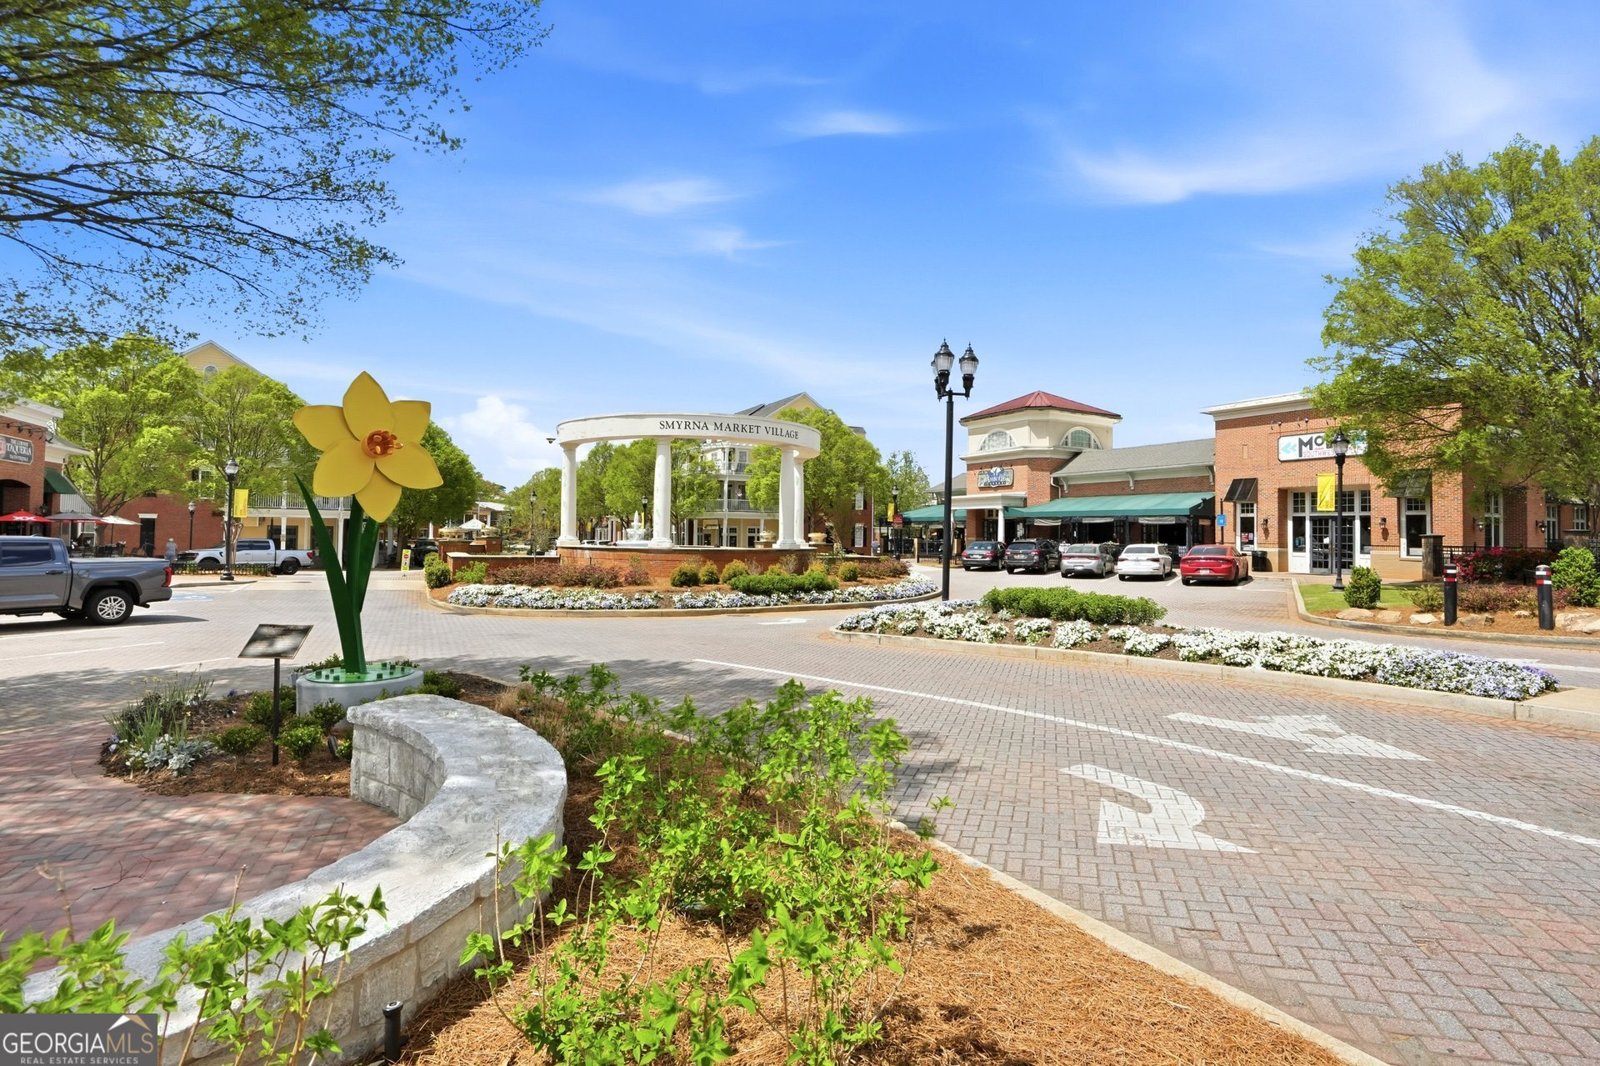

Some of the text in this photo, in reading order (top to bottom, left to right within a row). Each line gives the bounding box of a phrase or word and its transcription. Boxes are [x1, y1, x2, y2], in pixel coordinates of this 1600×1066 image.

[659, 420, 799, 439] SMYRNA MARKET VILLAGE
[6, 443, 32, 456] TAQUERIA
